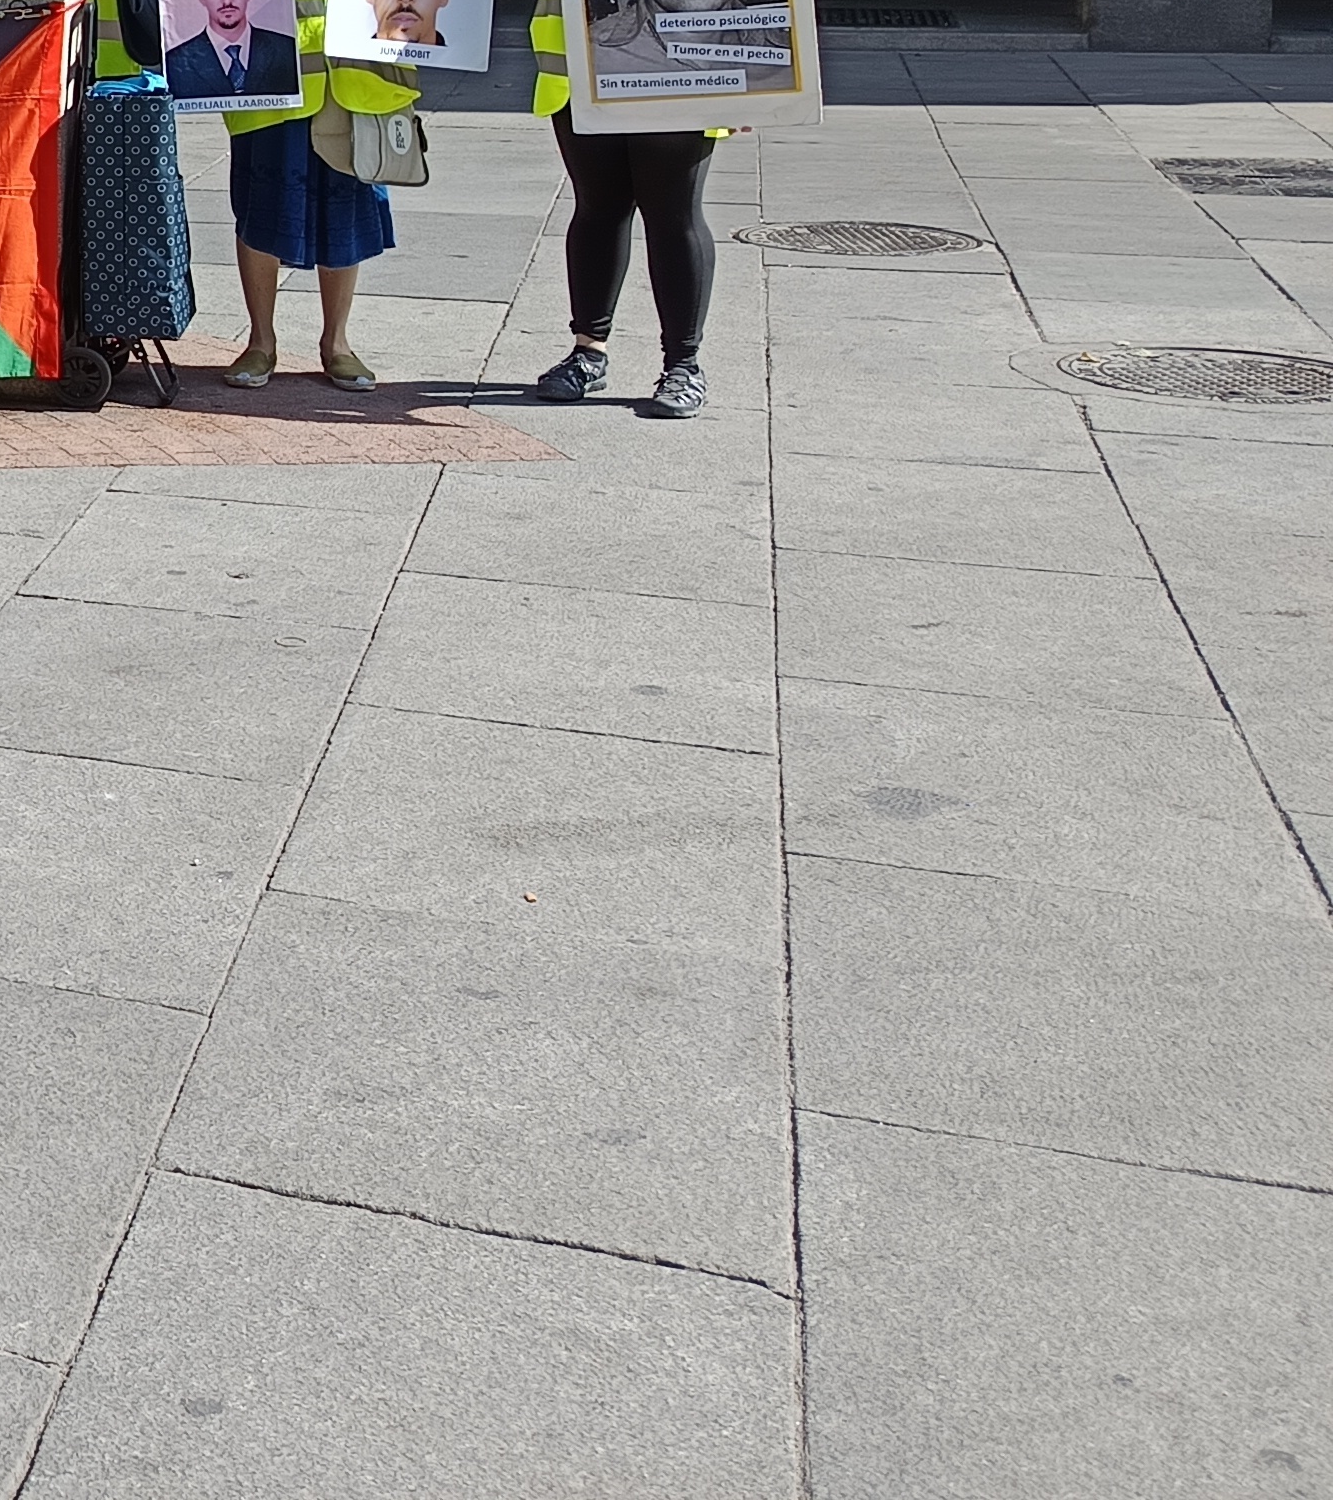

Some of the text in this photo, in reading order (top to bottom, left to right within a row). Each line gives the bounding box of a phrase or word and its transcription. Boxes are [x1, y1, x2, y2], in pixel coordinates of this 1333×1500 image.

[659, 13, 787, 29] deterioro psicológico
[380, 46, 431, 60] JUNA BOBIT
[673, 44, 784, 61] Tumor en el pecho
[600, 75, 740, 89] Sin tratamiento médico
[177, 99, 233, 111] ABDELJALIL
